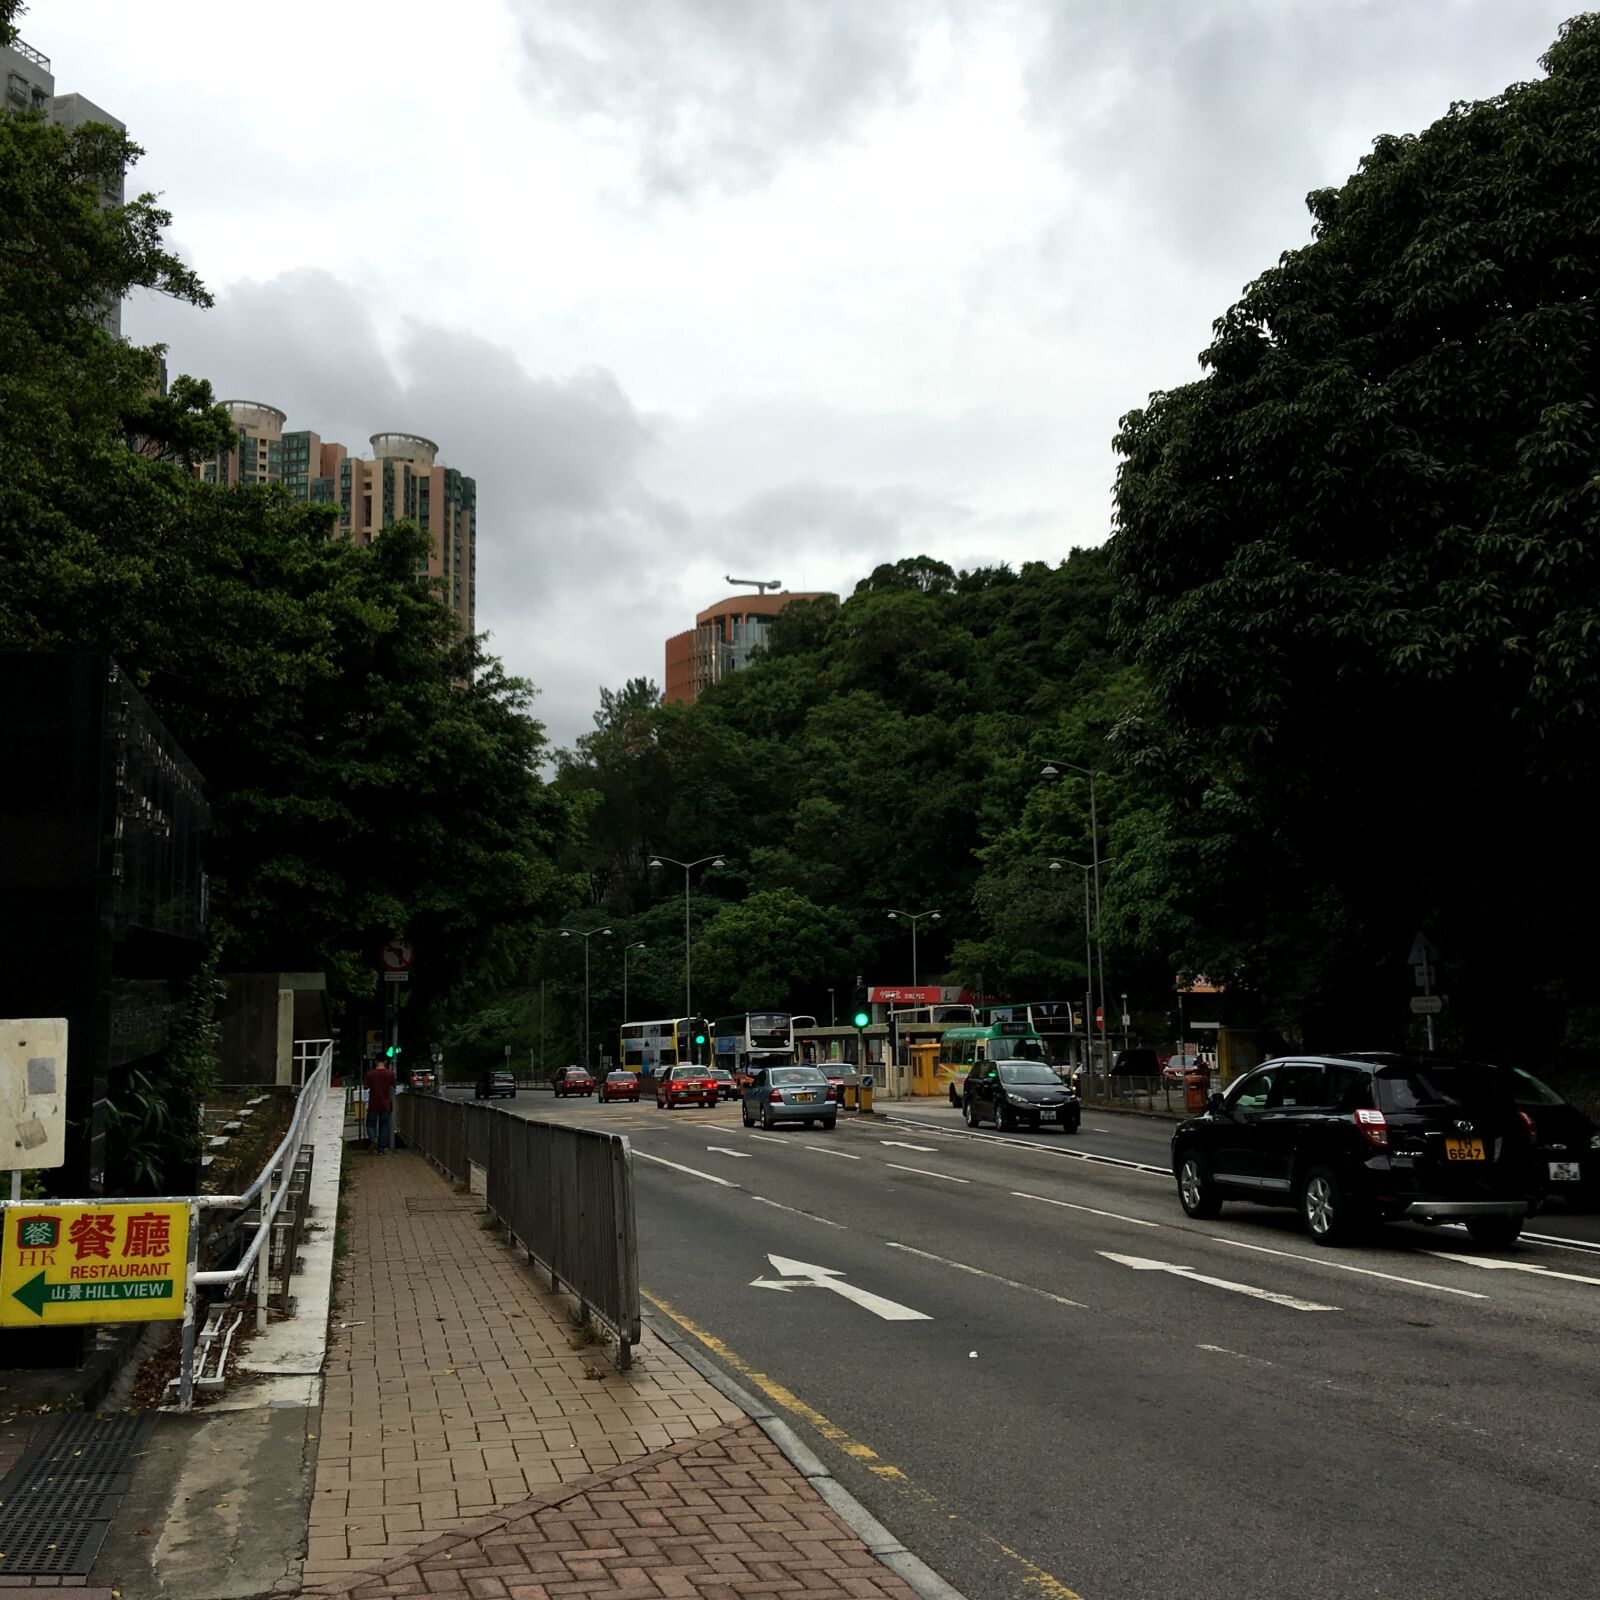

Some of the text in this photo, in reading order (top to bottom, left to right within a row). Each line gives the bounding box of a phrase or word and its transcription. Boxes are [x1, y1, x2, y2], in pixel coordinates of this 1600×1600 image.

[1450, 1148, 1481, 1159] 6647
[67, 1212, 171, 1260] 餐廳
[18, 1250, 56, 1266] HK
[70, 1262, 171, 1279] RESTAURANT
[51, 1285, 81, 1300] 山景
[85, 1282, 164, 1299] HILL VIEW
